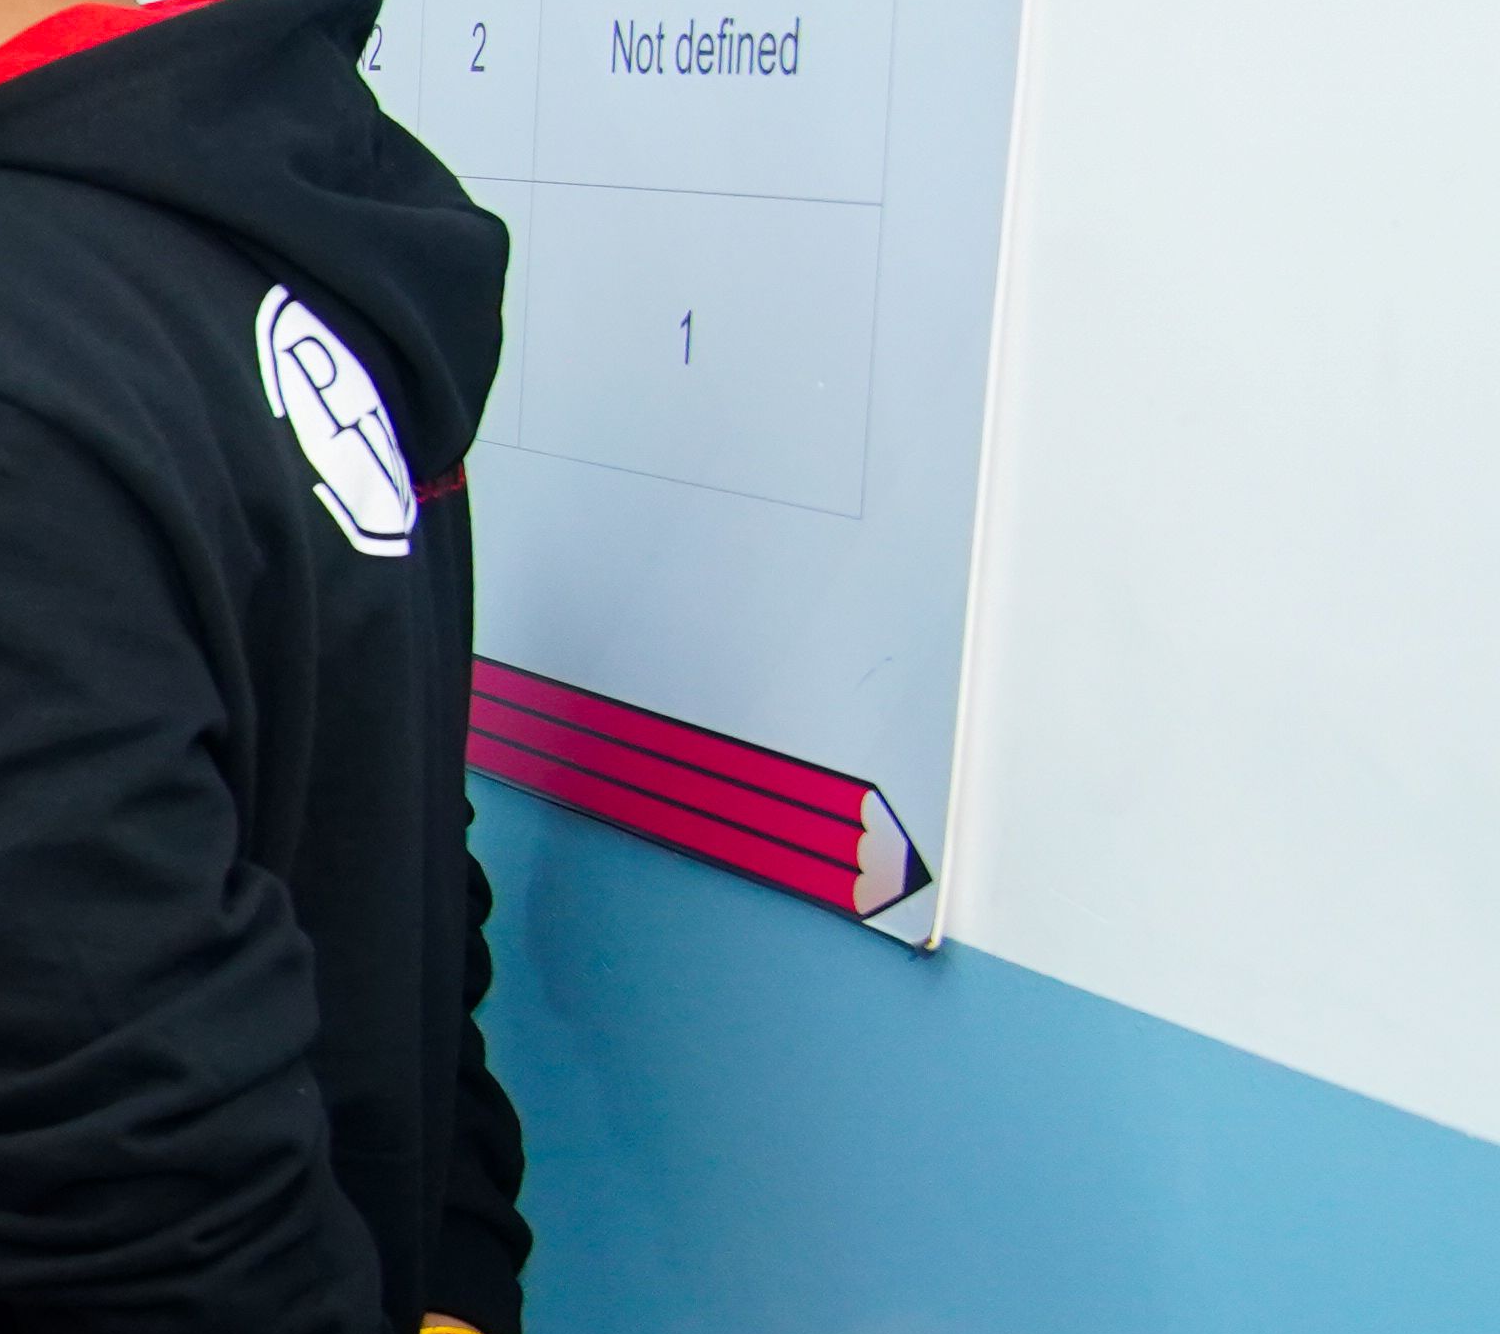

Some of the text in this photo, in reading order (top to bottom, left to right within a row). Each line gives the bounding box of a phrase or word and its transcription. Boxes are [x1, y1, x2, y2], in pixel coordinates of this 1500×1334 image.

[469, 21, 487, 73] 2
[611, 15, 802, 77] Not defined
[679, 309, 694, 366] 1
